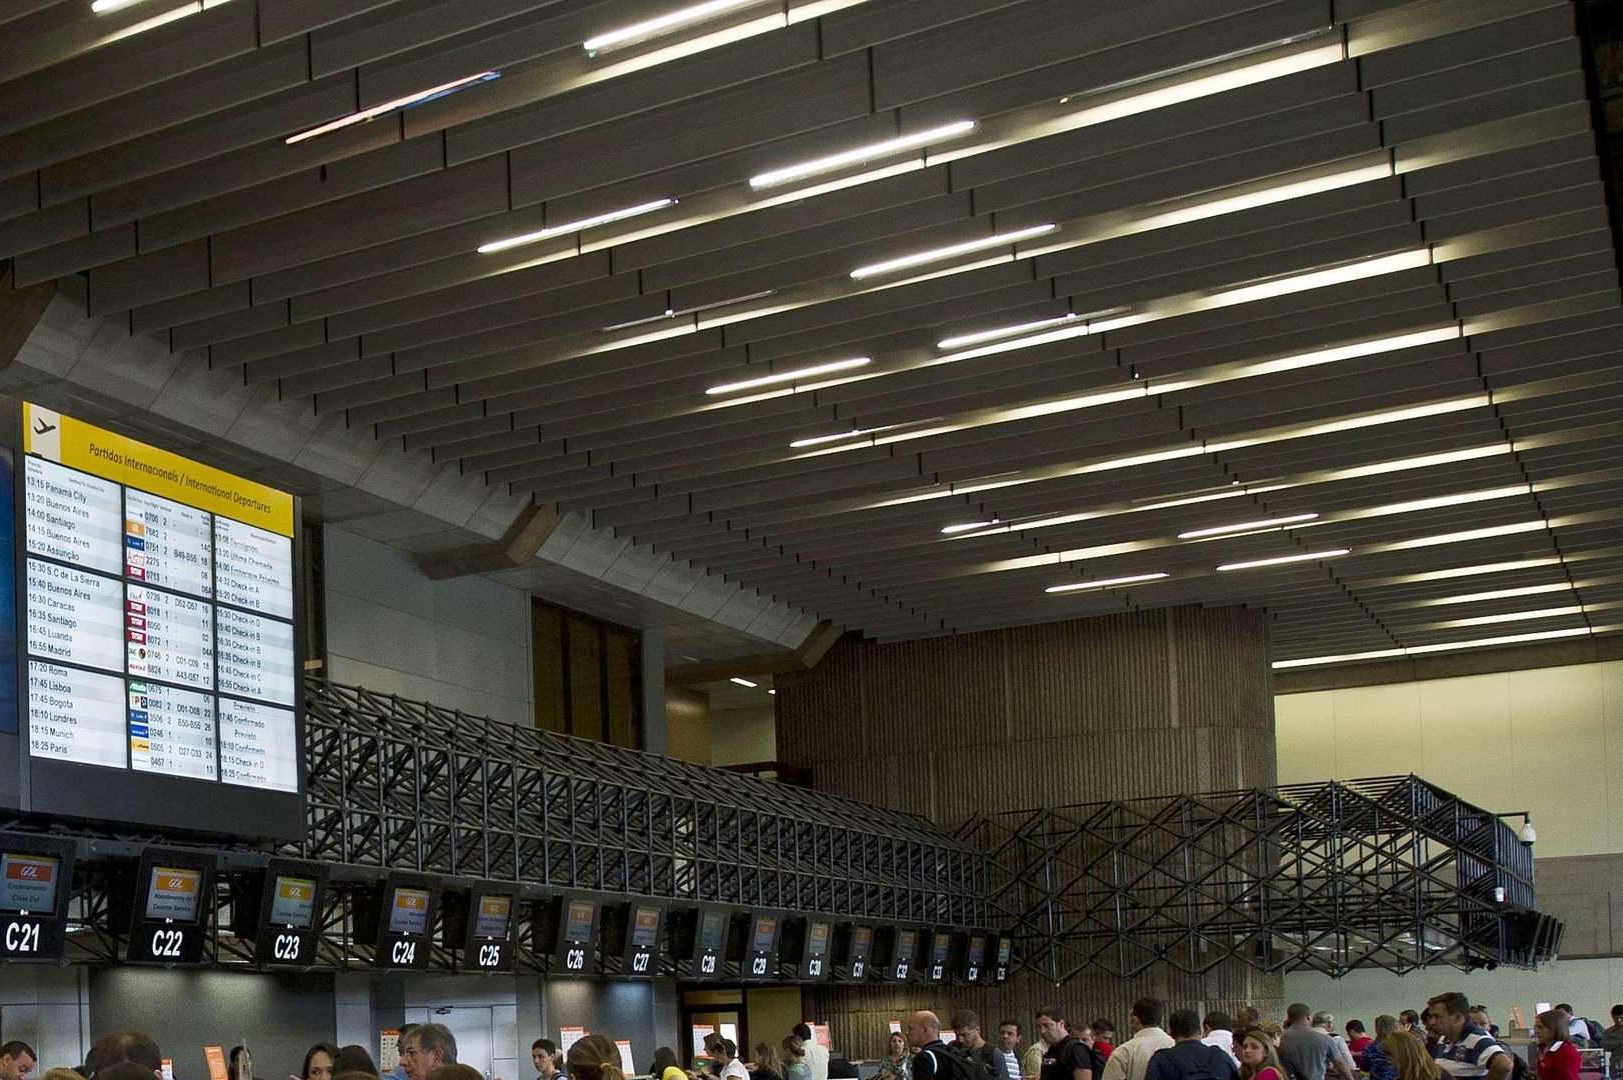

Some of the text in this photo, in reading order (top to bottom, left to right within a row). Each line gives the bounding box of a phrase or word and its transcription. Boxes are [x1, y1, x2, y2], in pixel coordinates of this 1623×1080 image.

[89, 443, 271, 513] Partidas Internacionais / International Departures
[46, 498, 89, 518] Buenos Aires
[46, 513, 75, 530] Santiago
[48, 645, 71, 656] Madrid
[49, 666, 68, 677] Roma
[50, 713, 77, 724] Londres
[50, 744, 67, 753] Paris
[6, 922, 40, 951] C21
[152, 930, 183, 956] C22
[275, 934, 300, 959] C23
[392, 942, 415, 964] C24
[479, 946, 500, 966] C25
[567, 950, 584, 969] C26
[633, 953, 649, 972] C27
[702, 955, 715, 973] C28
[753, 958, 766, 975] C29
[809, 960, 821, 975] C30
